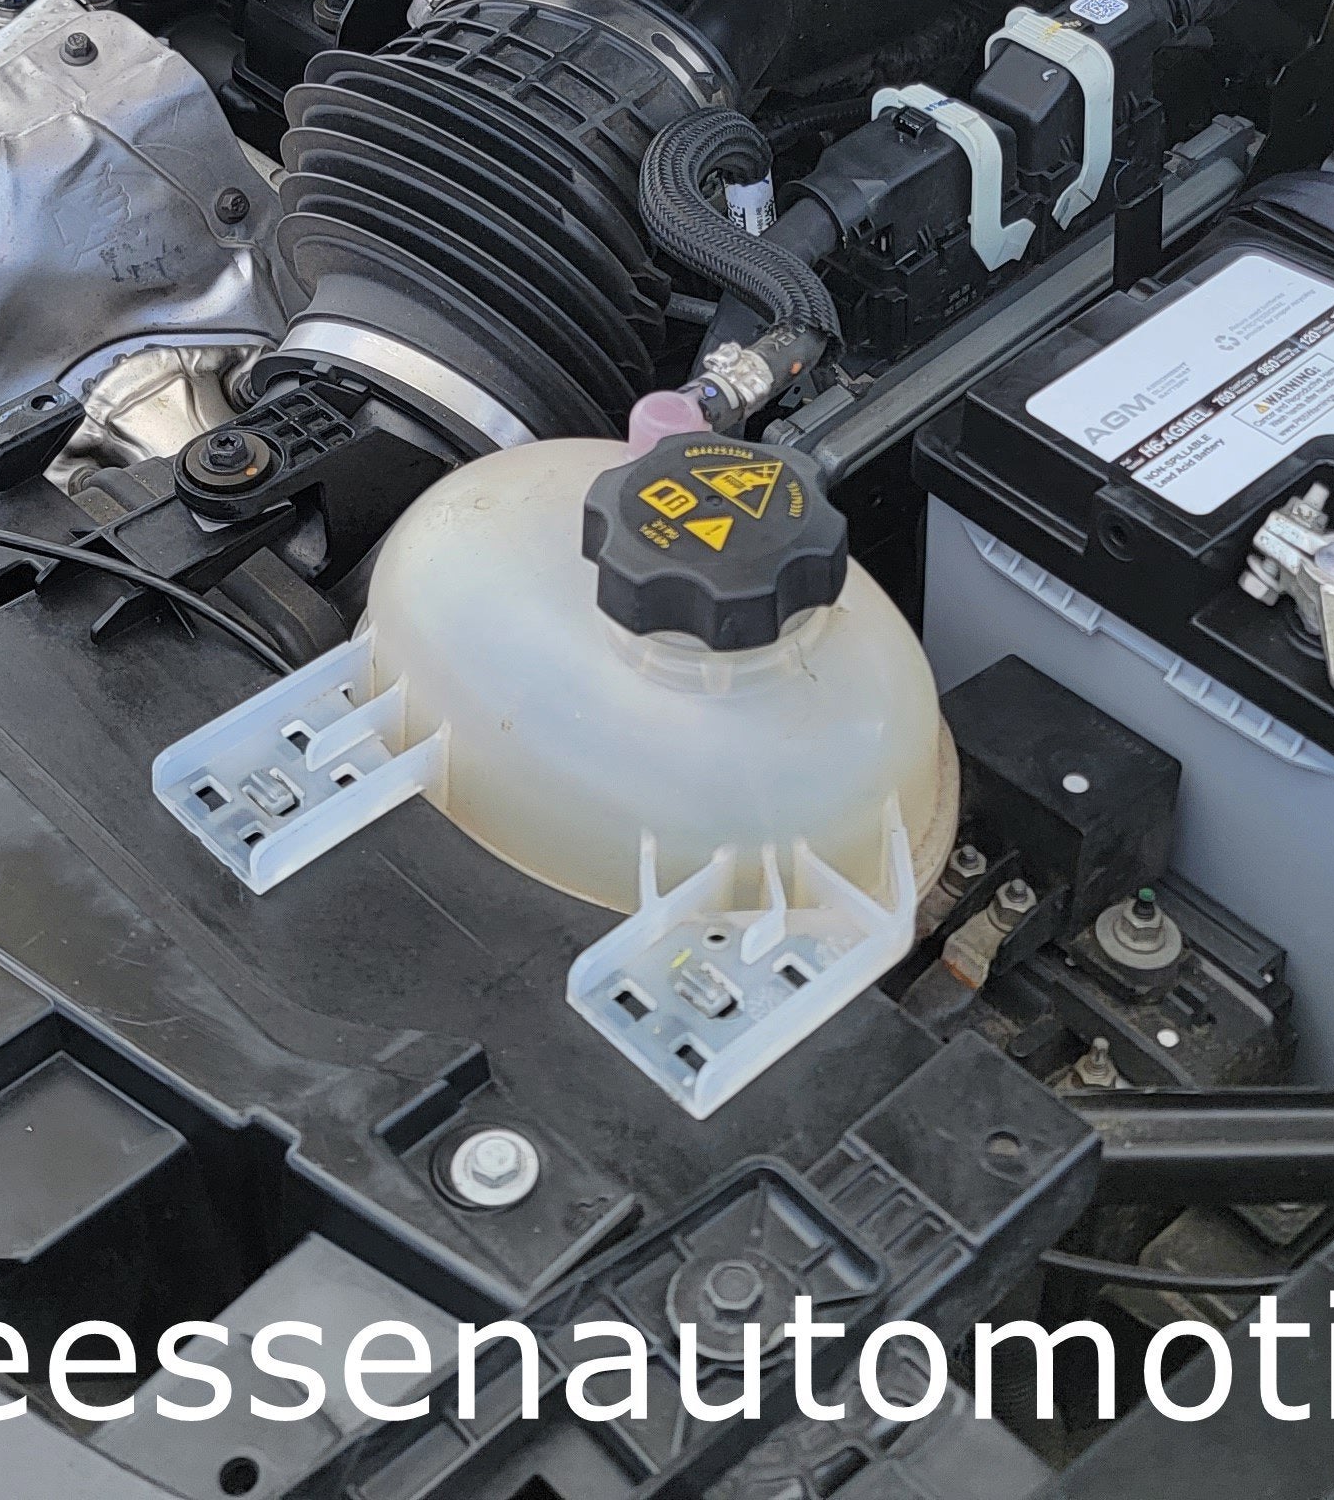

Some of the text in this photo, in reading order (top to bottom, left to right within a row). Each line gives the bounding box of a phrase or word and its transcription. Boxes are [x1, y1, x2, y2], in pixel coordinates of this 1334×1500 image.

[1295, 329, 1324, 346] 120
[1253, 358, 1283, 376] 950
[1257, 364, 1325, 407] WARNING:
[1083, 391, 1159, 446] AGM
[1133, 388, 1240, 459] H6-AGMEL 760
[1139, 432, 1215, 482] NON-SPILLABLE
[1151, 437, 1229, 489] Lead Acid Battery
